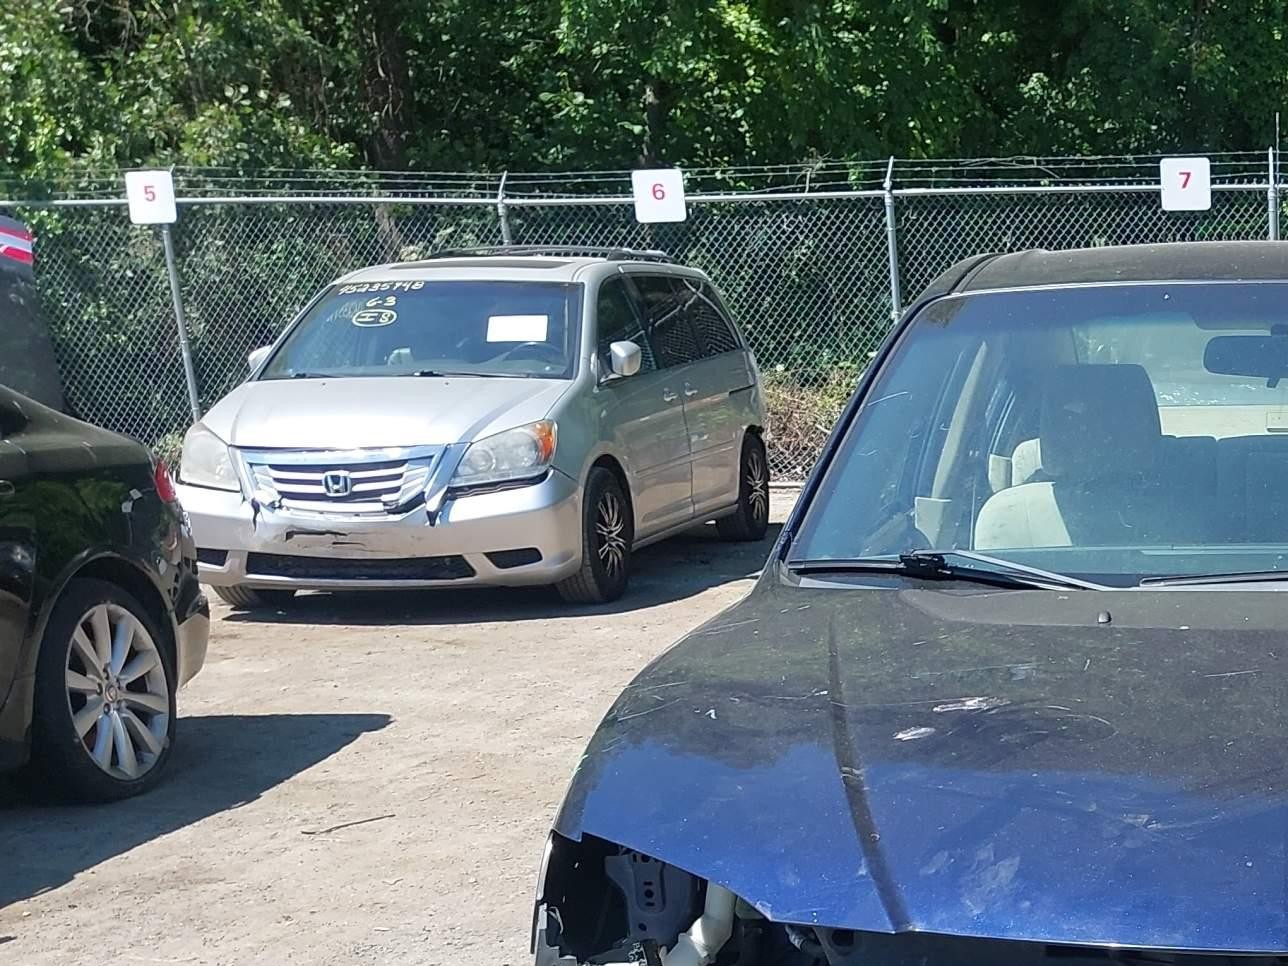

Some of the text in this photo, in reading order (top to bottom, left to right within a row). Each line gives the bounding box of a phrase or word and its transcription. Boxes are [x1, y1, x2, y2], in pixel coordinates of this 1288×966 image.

[1179, 171, 1191, 189] 7
[144, 185, 156, 202] 5
[652, 183, 666, 201] 6
